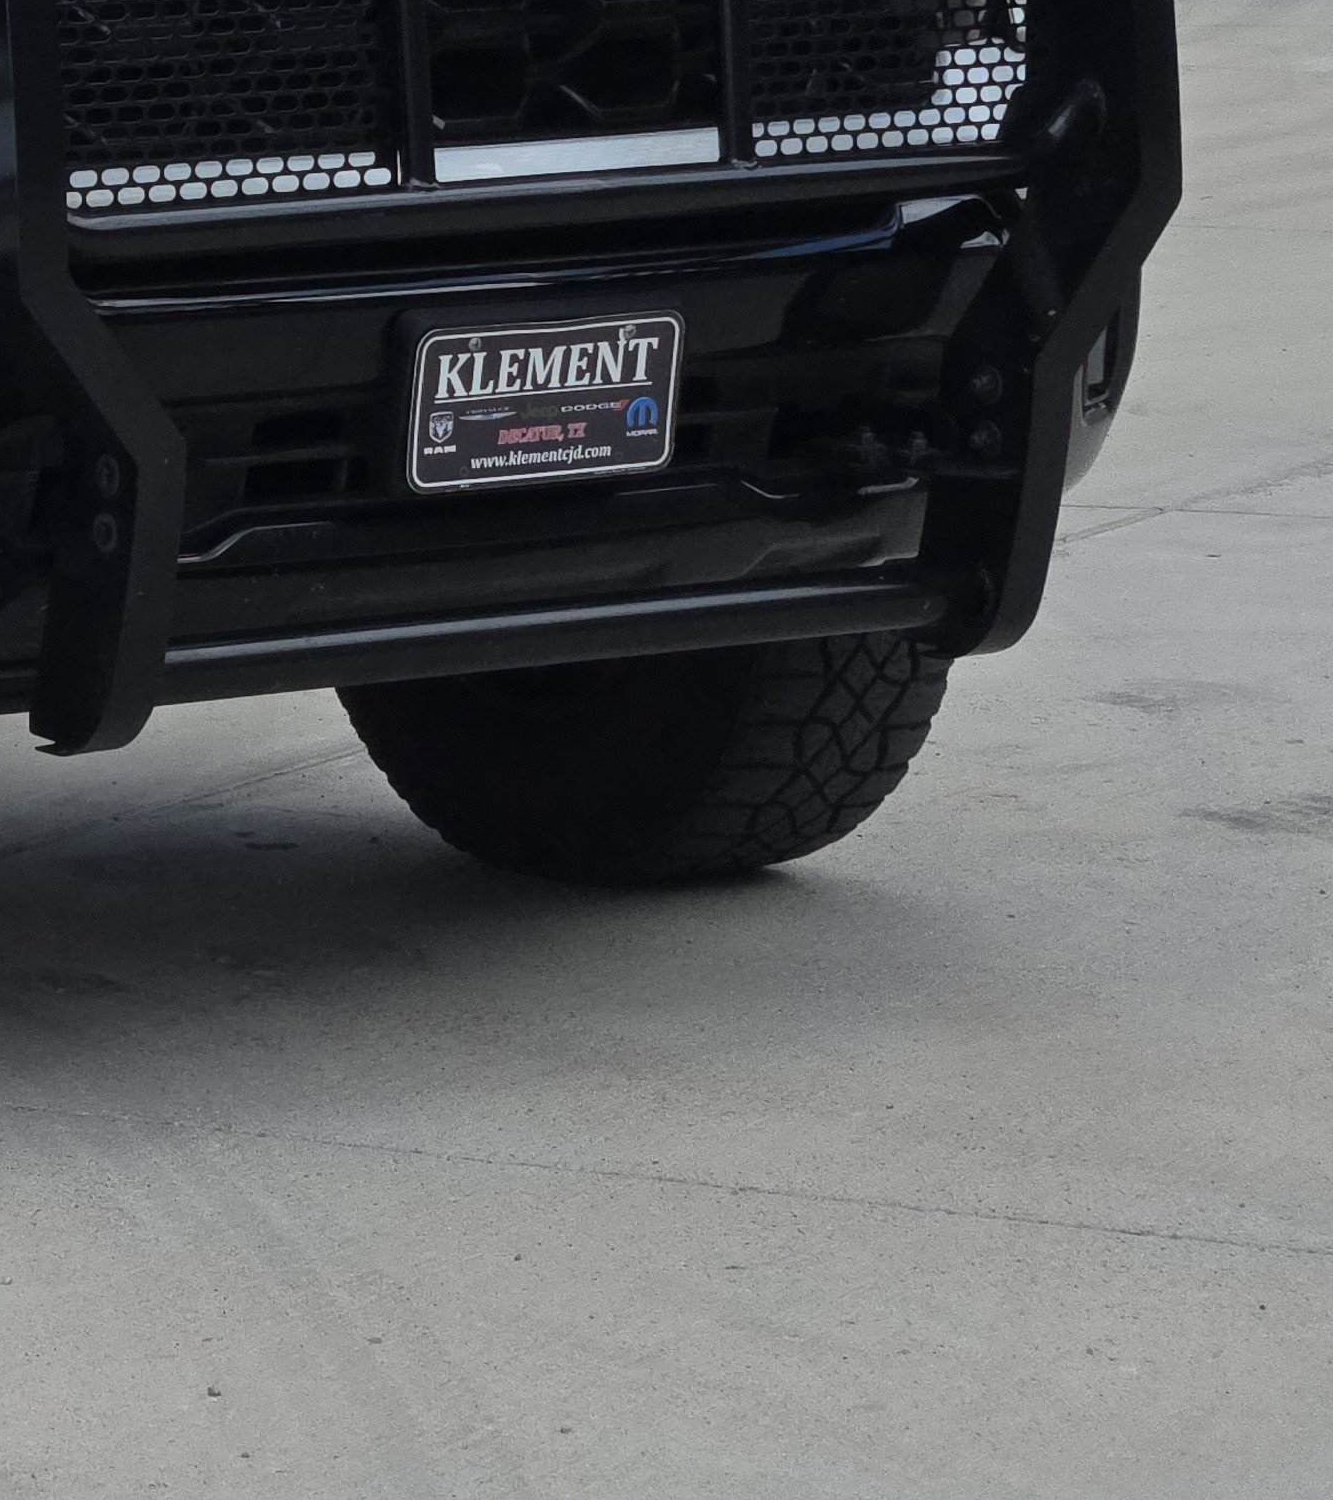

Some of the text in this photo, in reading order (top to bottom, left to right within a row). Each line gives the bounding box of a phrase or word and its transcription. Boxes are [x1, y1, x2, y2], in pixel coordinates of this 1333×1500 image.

[434, 337, 659, 399] KLEMENT
[560, 401, 621, 413] DODGE
[567, 422, 588, 439] TX
[424, 445, 457, 455] RAM
[470, 444, 612, 470] www.klementcjd.com
